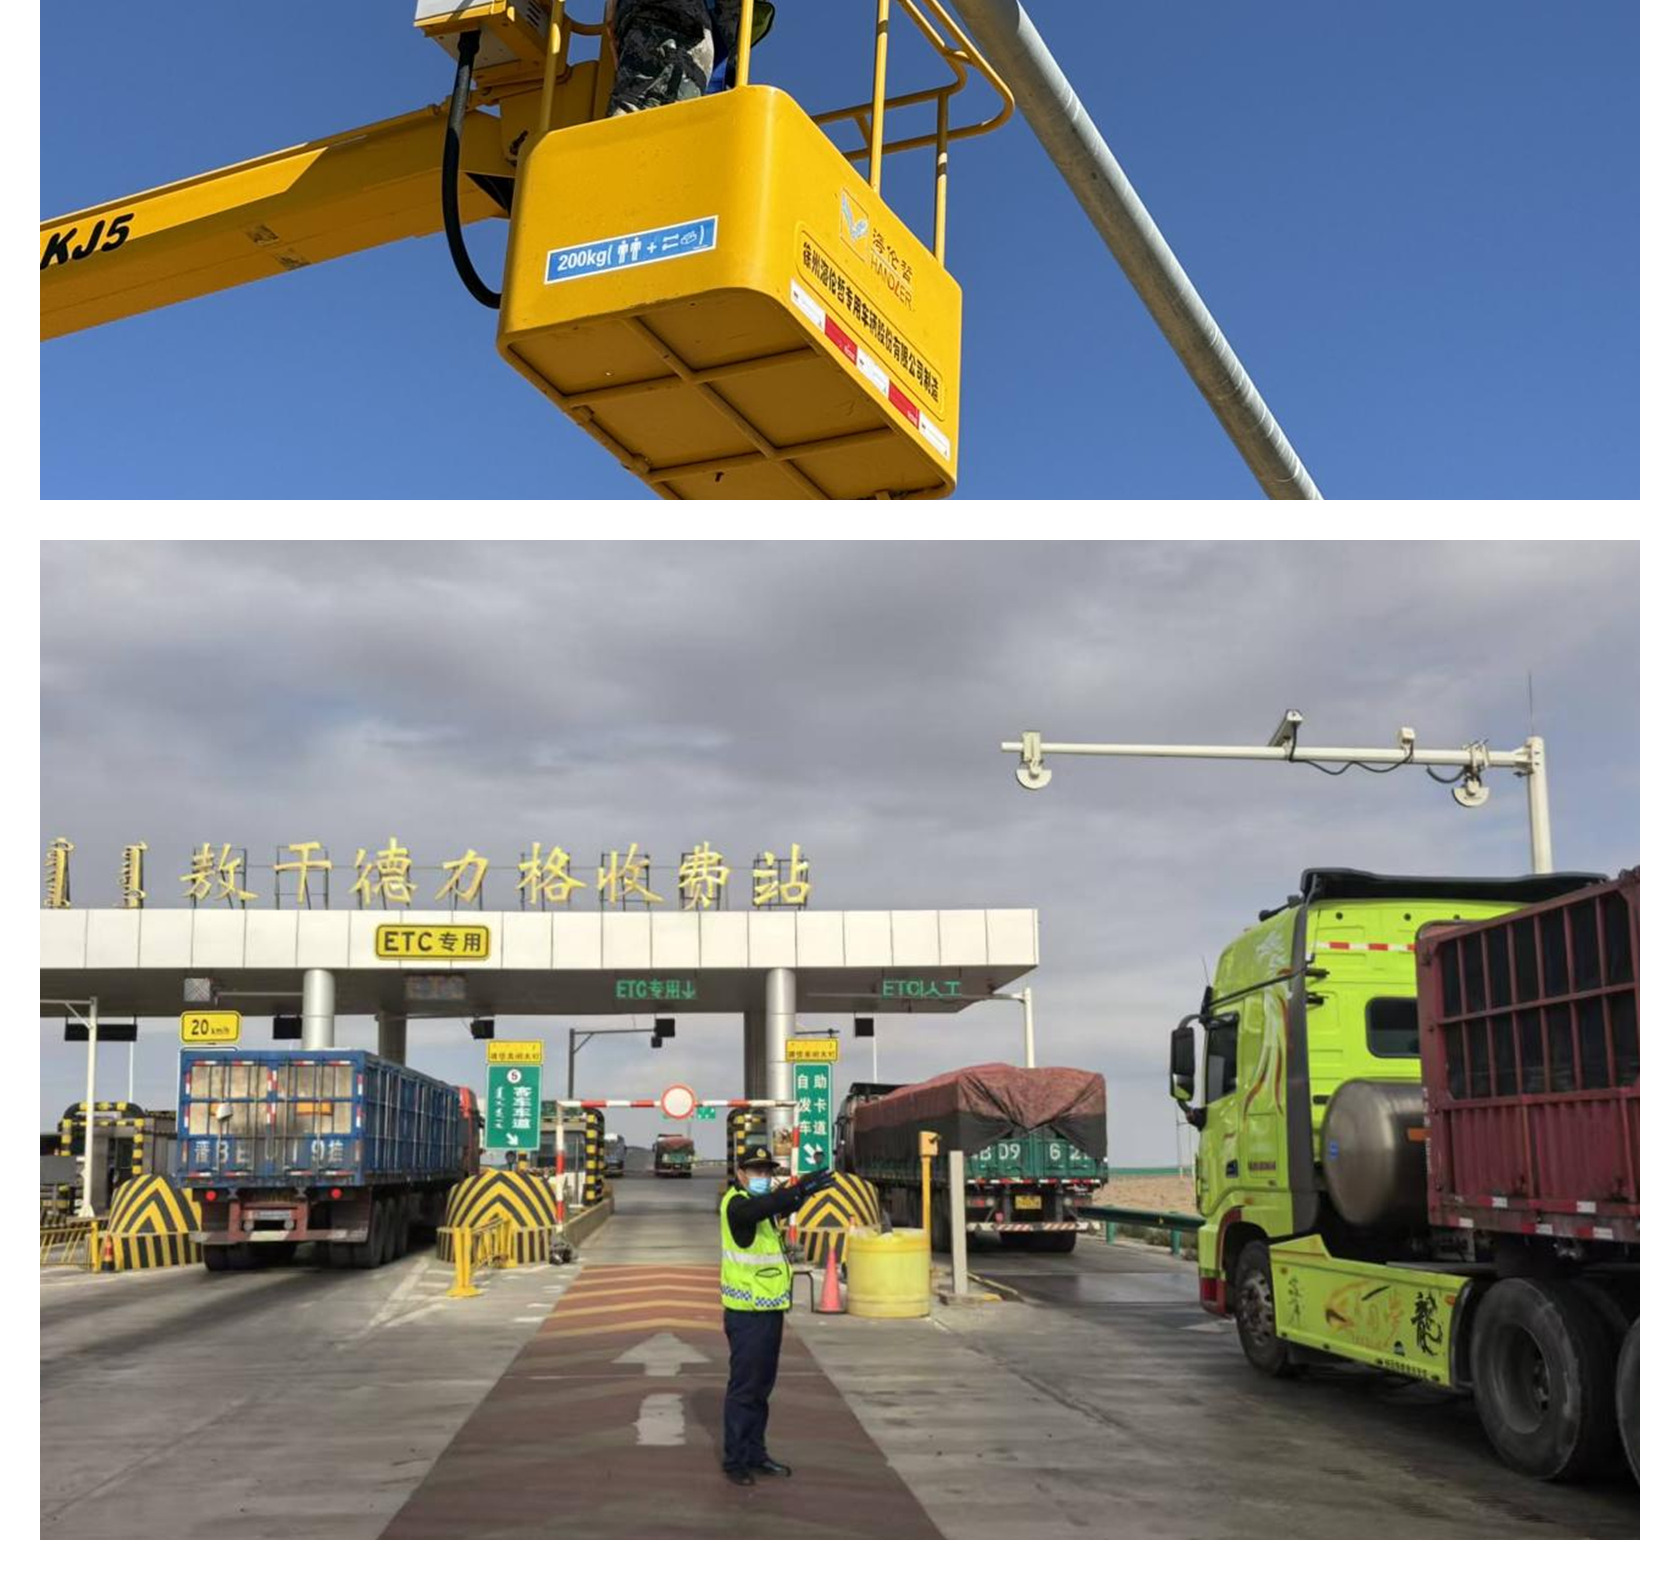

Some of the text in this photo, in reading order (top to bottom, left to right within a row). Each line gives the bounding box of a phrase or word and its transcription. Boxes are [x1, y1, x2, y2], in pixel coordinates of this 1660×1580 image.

[870, 257, 913, 307] HANDLER
[191, 1019, 208, 1035] 20
[798, 1073, 827, 1089] 自助
[799, 1120, 827, 1135] 车道
